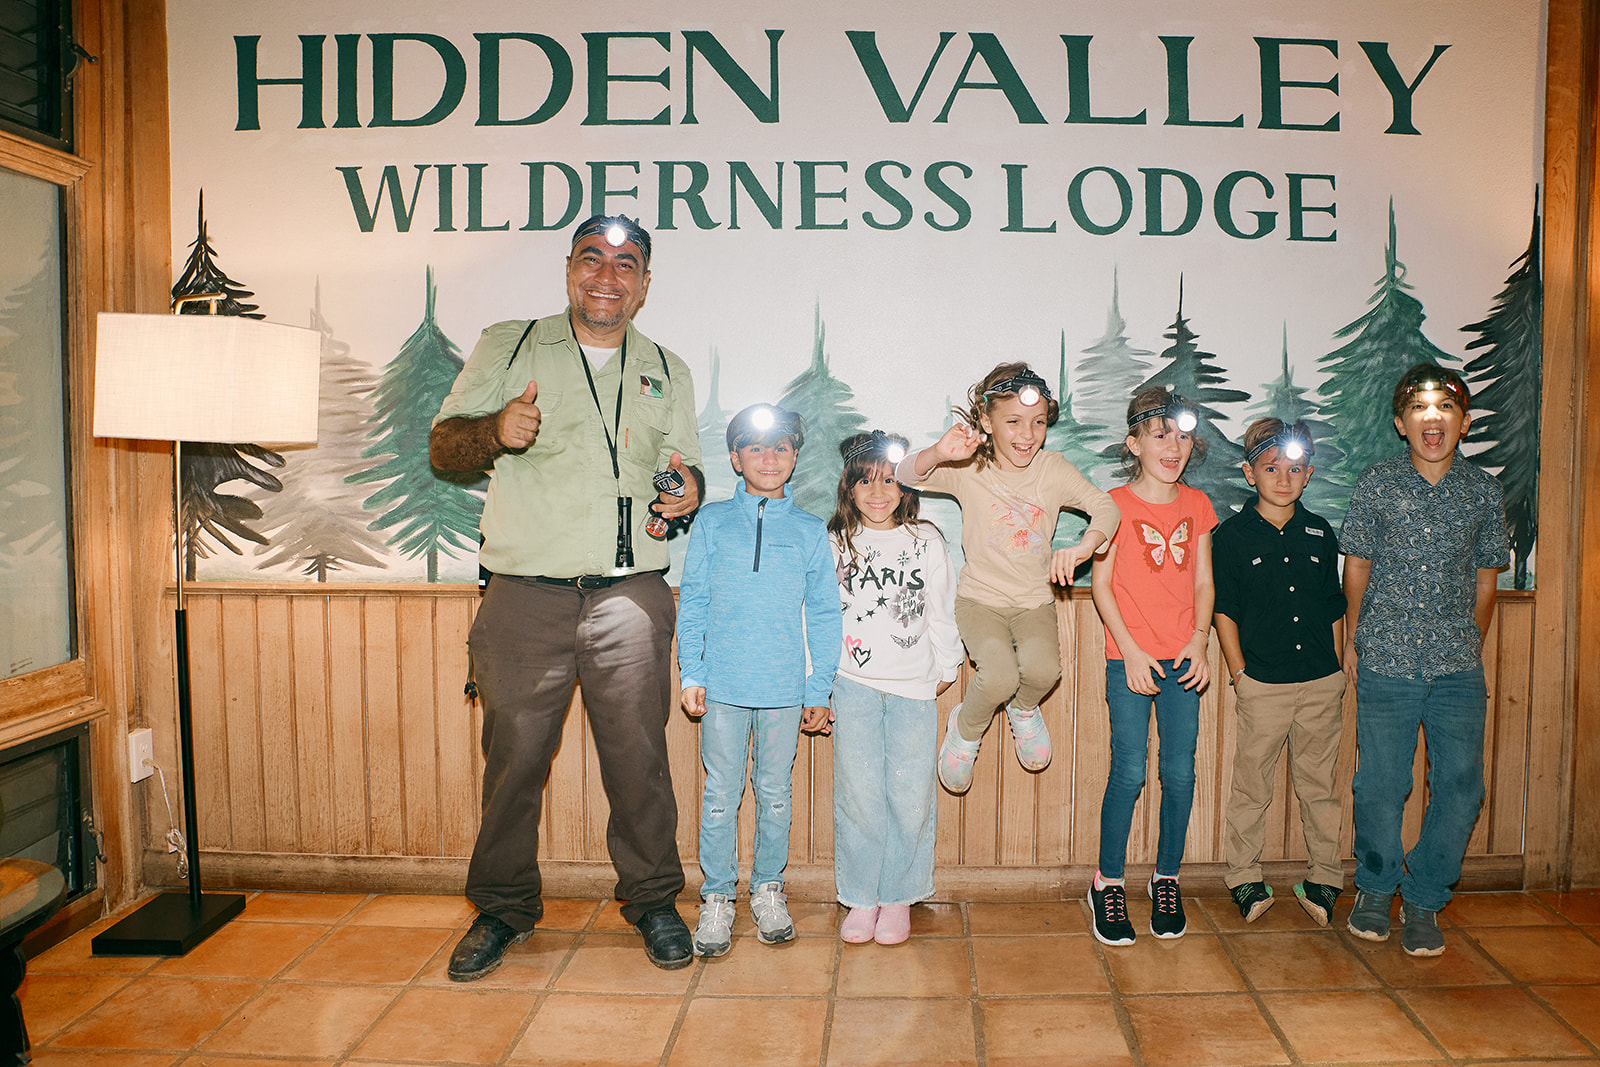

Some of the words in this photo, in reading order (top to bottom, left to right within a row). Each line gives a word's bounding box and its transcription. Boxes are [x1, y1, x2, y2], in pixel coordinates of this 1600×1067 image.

[234, 30, 784, 131] HIDDEN
[845, 31, 1452, 135] VALLEY
[336, 161, 973, 233] WILDERNESS
[1000, 164, 1337, 242] LODGE
[844, 564, 925, 591] PARIS
